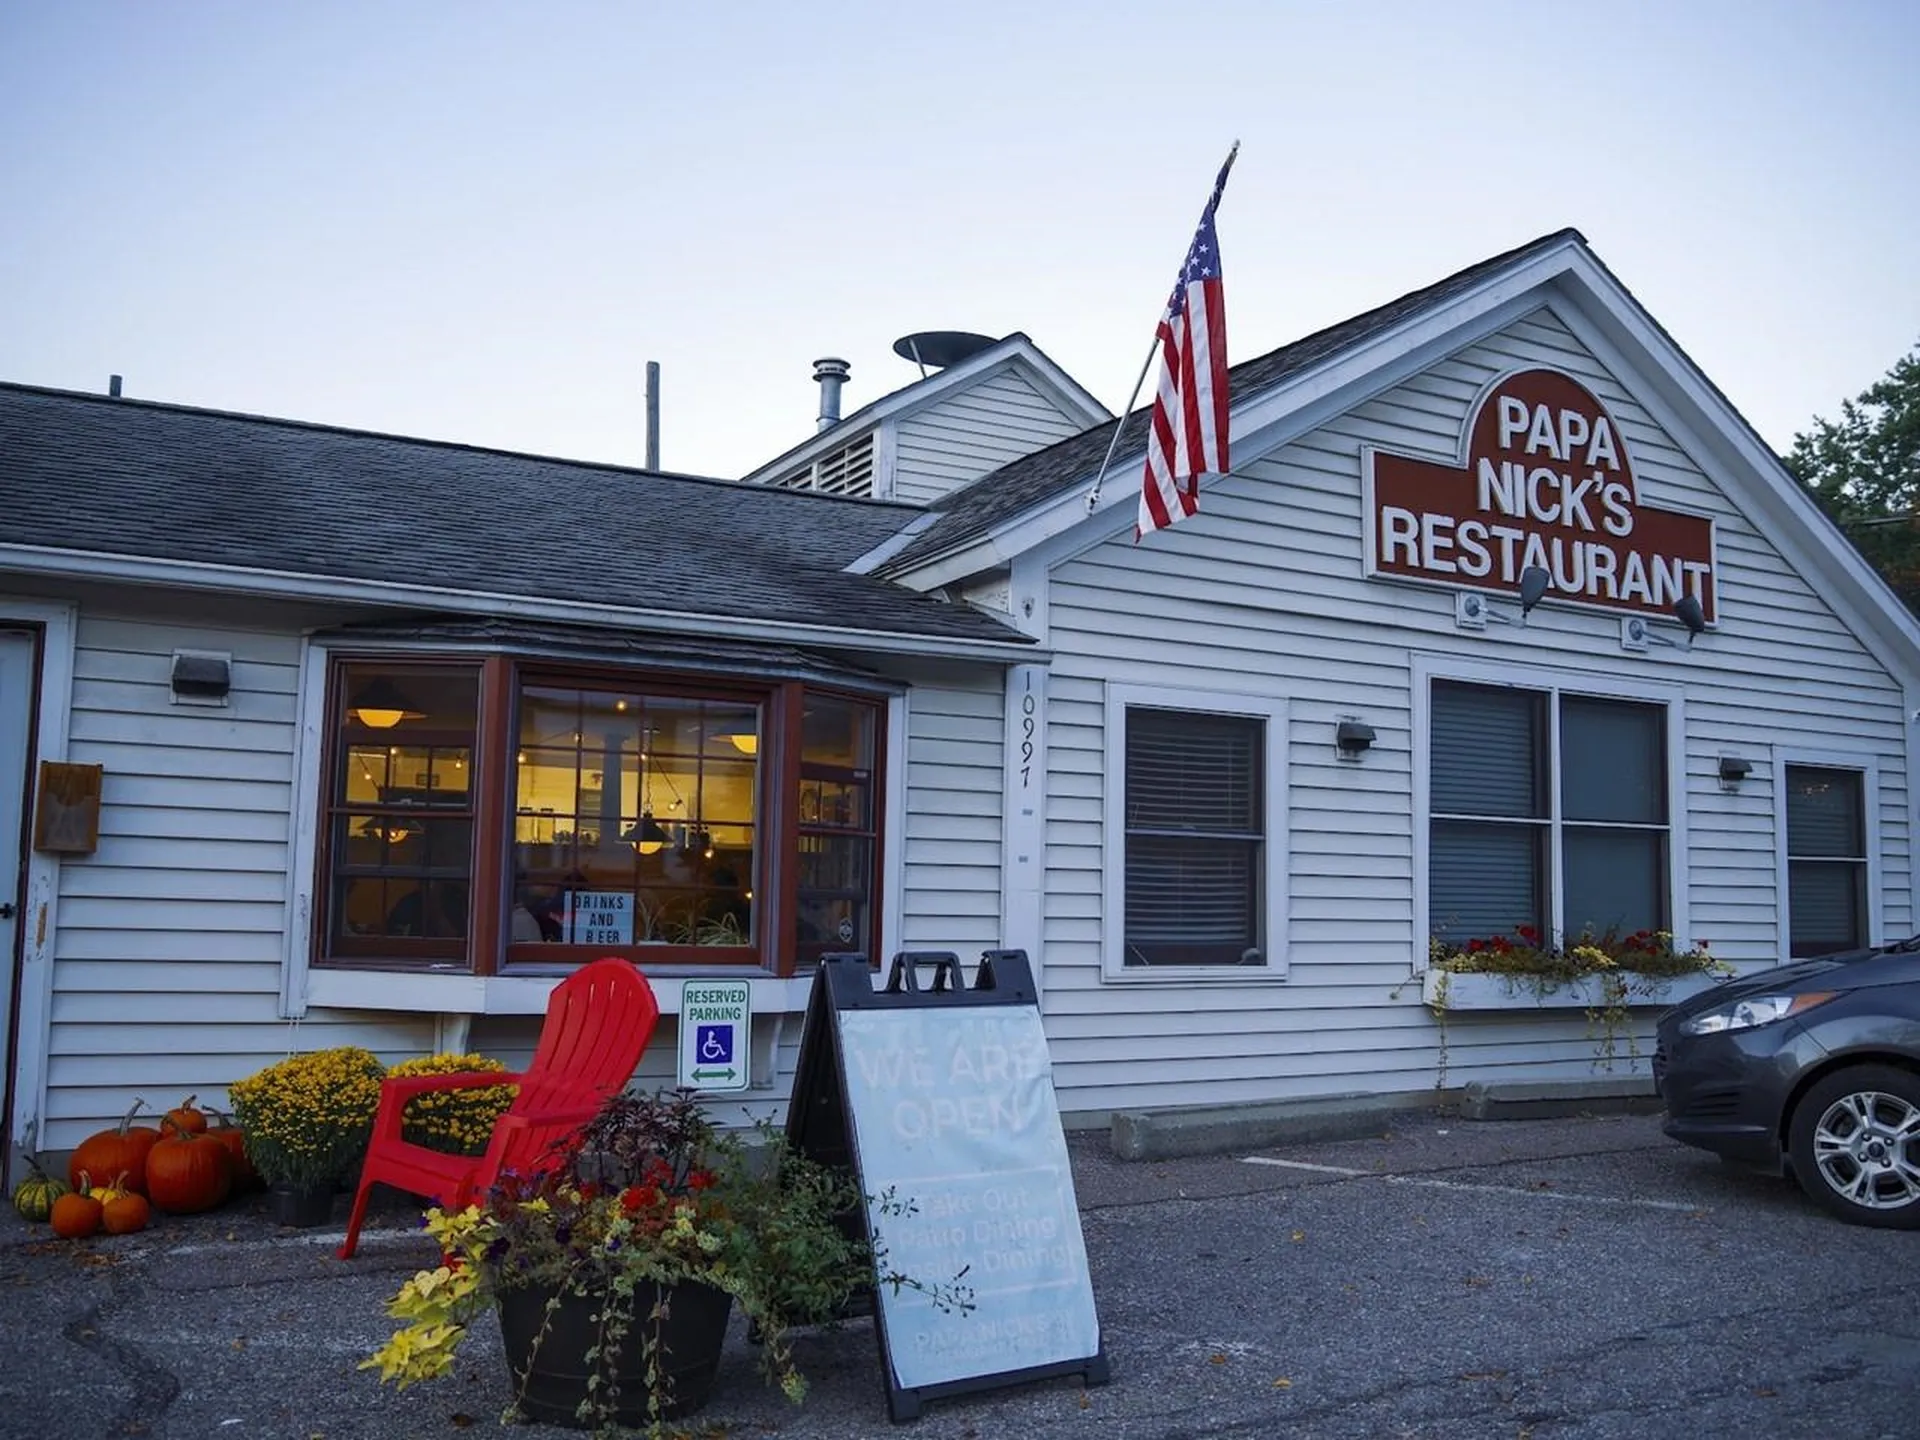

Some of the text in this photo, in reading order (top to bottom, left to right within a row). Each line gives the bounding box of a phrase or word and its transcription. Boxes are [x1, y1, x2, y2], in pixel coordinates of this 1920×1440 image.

[1498, 395, 1620, 471] PAPA
[1476, 456, 1634, 537] NICK'S
[1380, 505, 1710, 612] RESTAURANT
[575, 895, 624, 910] DRINKS
[589, 913, 614, 926] AND
[586, 930, 620, 943] BEER
[686, 990, 746, 1003] RESERVED
[689, 1007, 741, 1020] PARKING
[855, 1042, 1038, 1088] WE ARE
[893, 1093, 1023, 1140] OPEN
